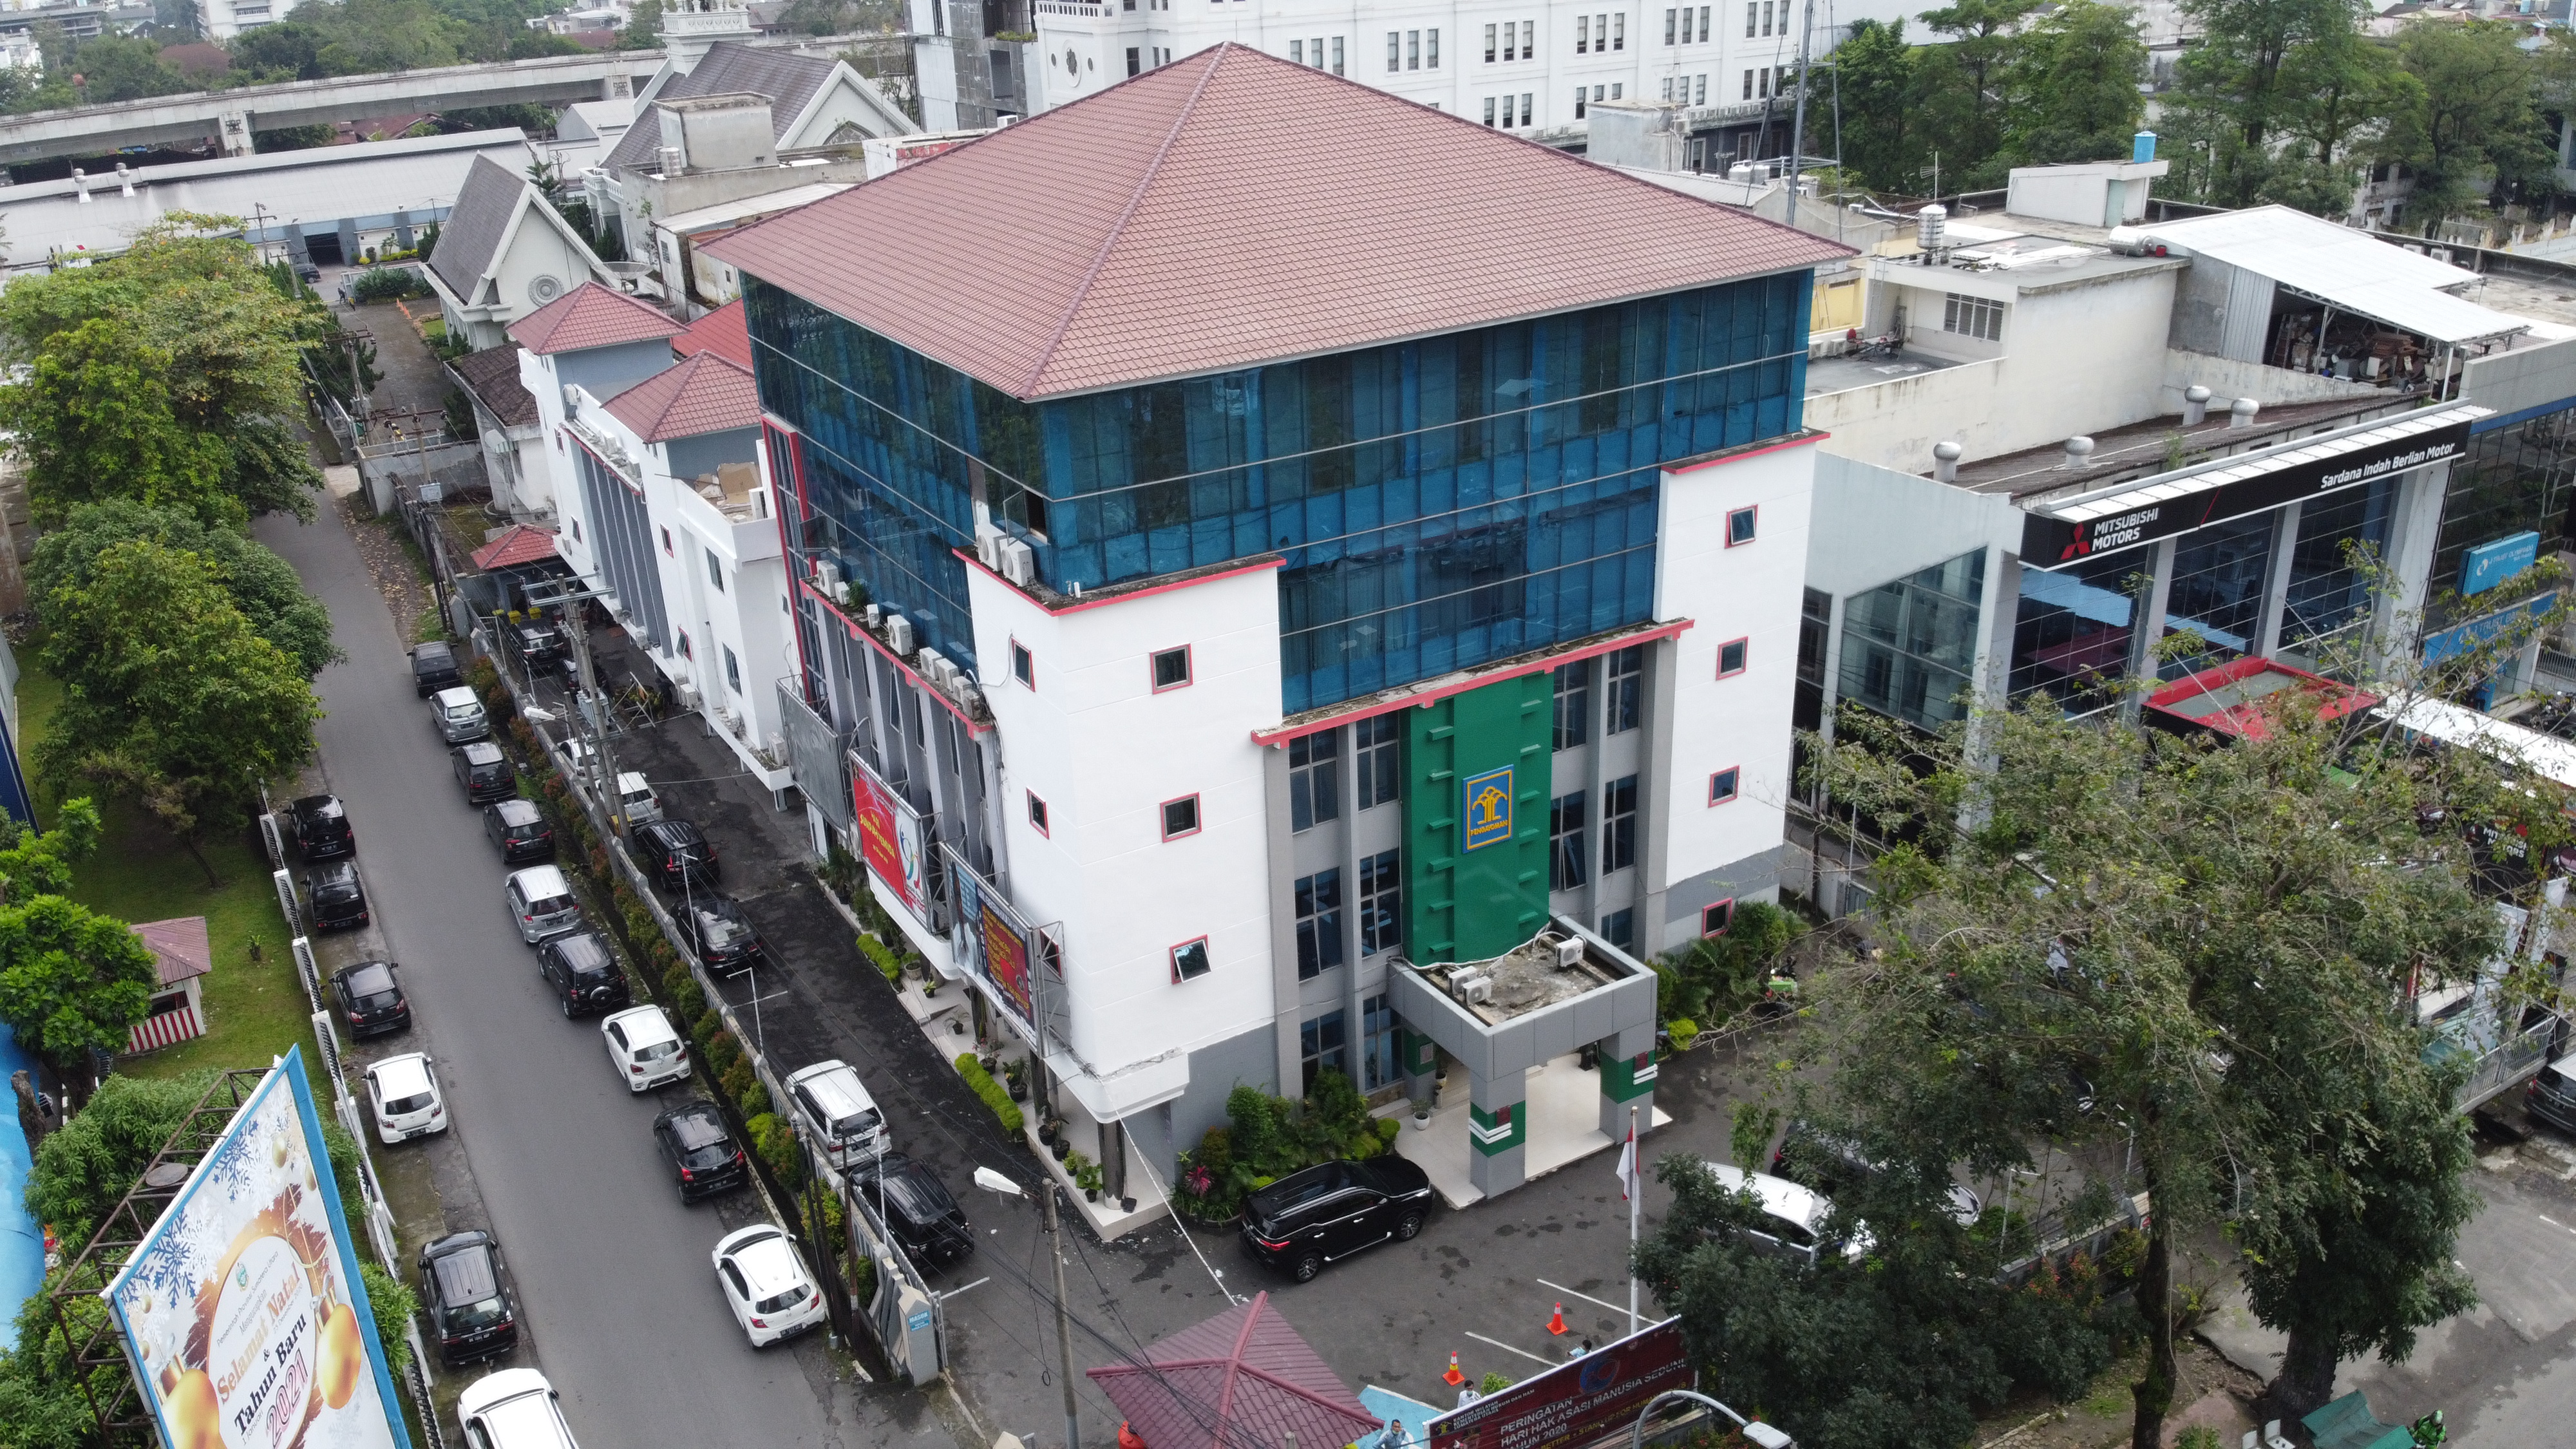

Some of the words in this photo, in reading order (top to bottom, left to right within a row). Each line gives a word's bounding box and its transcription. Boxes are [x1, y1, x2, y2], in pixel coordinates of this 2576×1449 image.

[2321, 468, 2362, 489] Sardana
[2363, 458, 2391, 477] Indah
[2392, 450, 2425, 469] Berlian
[2426, 442, 2455, 459] Motor
[2092, 527, 2141, 551] MOTORS
[2094, 507, 2159, 536] MITSUBISHI
[216, 1314, 239, 1347] Pemerintah
[238, 1293, 252, 1316] Provinsi
[252, 1267, 269, 1293] Sumatera
[268, 1251, 279, 1268] Utara
[239, 1289, 268, 1336] Mengucapkan
[278, 1301, 294, 1325] Desember
[217, 1315, 269, 1405] Selamat
[267, 1261, 300, 1325] Natal
[234, 1365, 277, 1436] Tahun
[275, 1312, 307, 1369] Baru
[263, 1348, 270, 1362] &
[265, 1347, 308, 1449] 2021
[1501, 1428, 1528, 1448] HARI
[1531, 1417, 1555, 1434] HAK
[1557, 1403, 1591, 1423] ASASI
[1593, 1378, 1643, 1408] MANUSIA
[1644, 1358, 1686, 1383] SEDUNI
[1501, 1396, 1573, 1435] PERINGATAN
[1511, 1394, 1522, 1403] DAN
[1523, 1389, 1535, 1397] HAM
[246, 1409, 263, 1441] Januari
[1543, 1423, 1567, 1440] 2020
